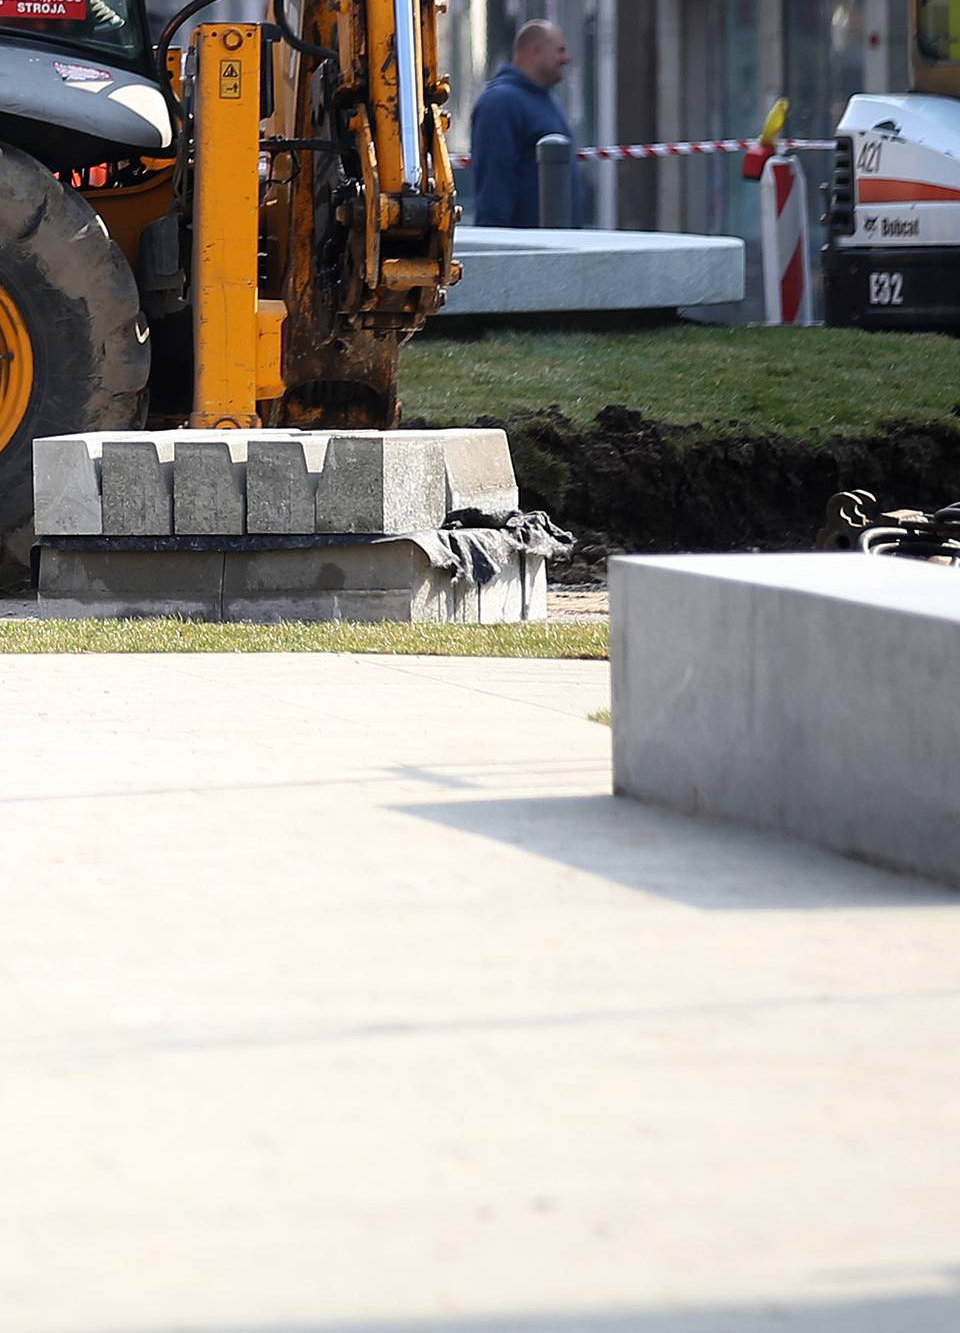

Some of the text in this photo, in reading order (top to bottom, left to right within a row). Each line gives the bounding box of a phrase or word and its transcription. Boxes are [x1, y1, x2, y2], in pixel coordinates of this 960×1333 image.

[17, 2, 66, 14] STROJA
[881, 218, 920, 237] Bobcat
[869, 272, 904, 305] E32
